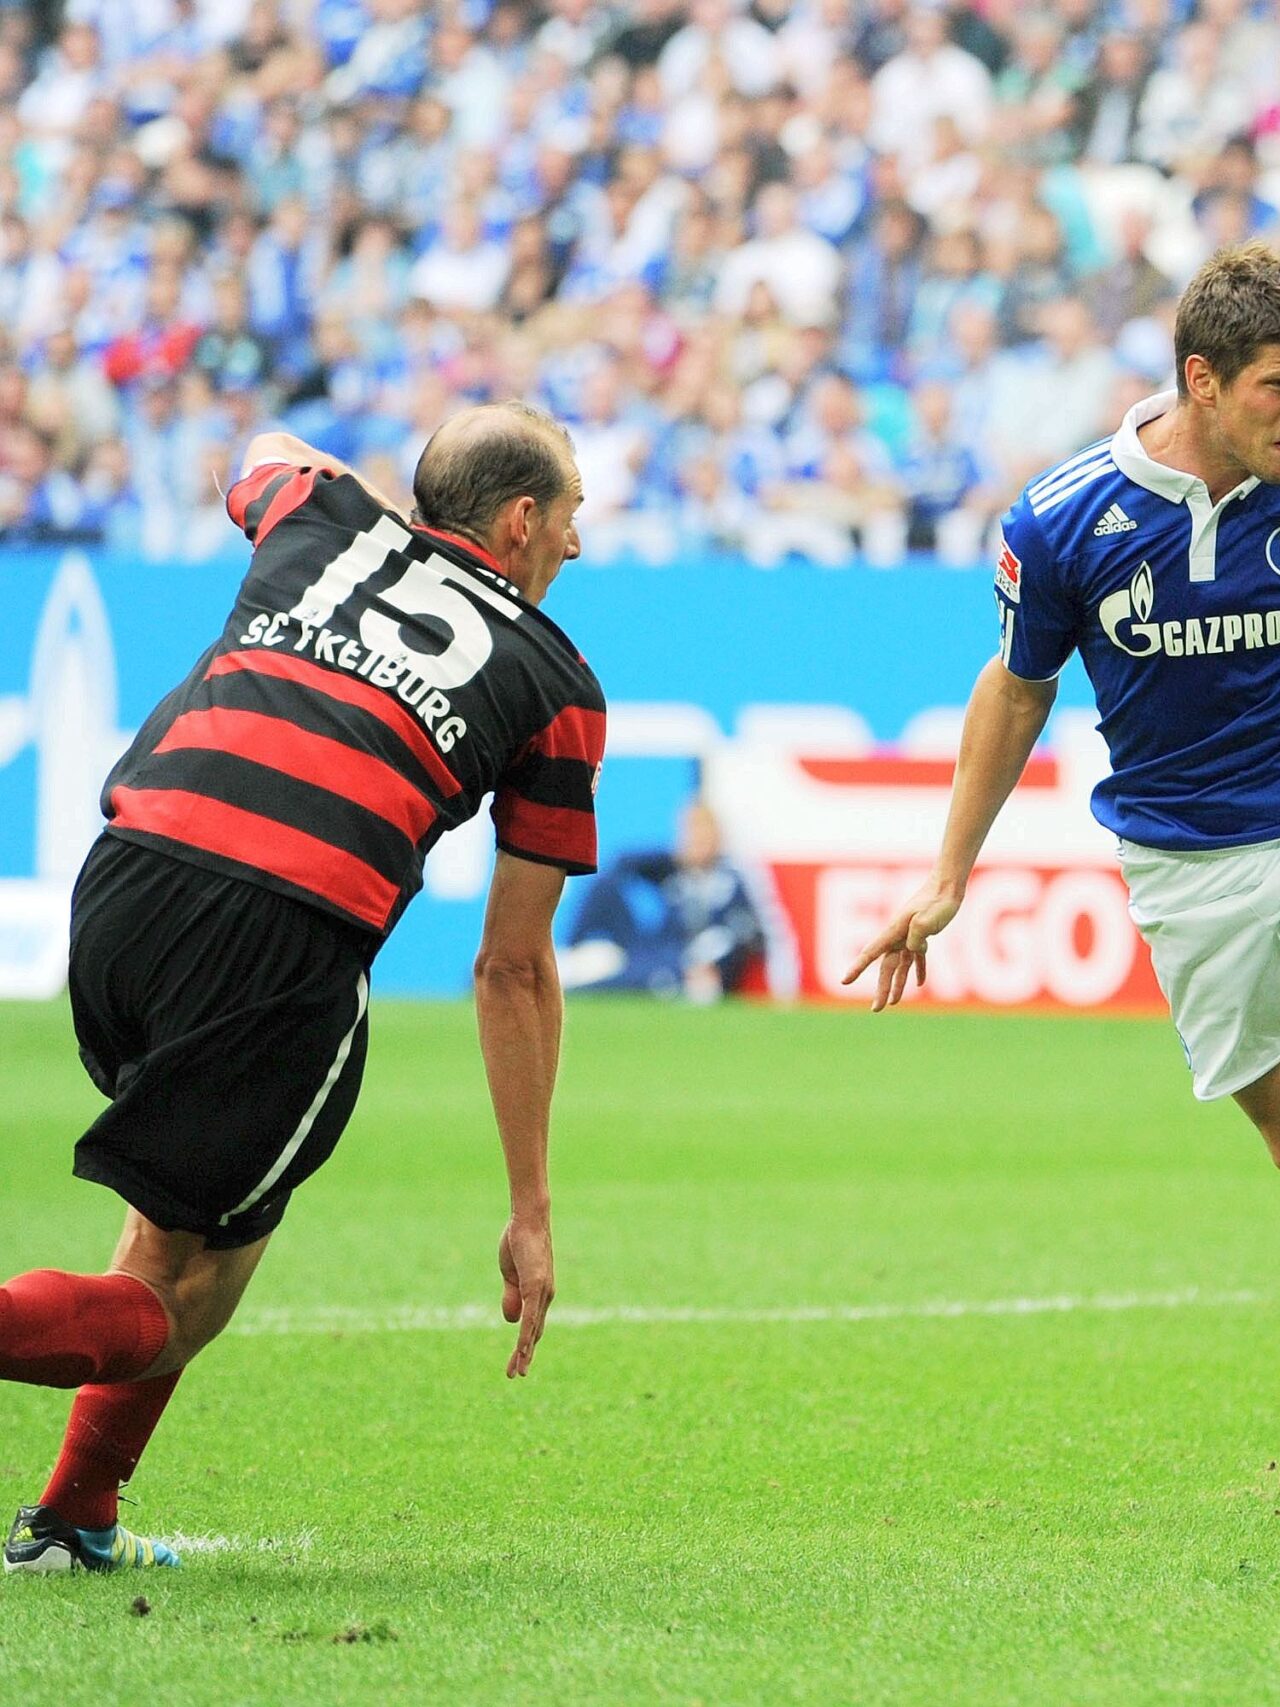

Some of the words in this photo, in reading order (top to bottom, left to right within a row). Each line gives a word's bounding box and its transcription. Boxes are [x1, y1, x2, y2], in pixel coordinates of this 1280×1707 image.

[1093, 519, 1138, 537] adidas
[289, 514, 524, 690] 15
[240, 612, 289, 646] SC
